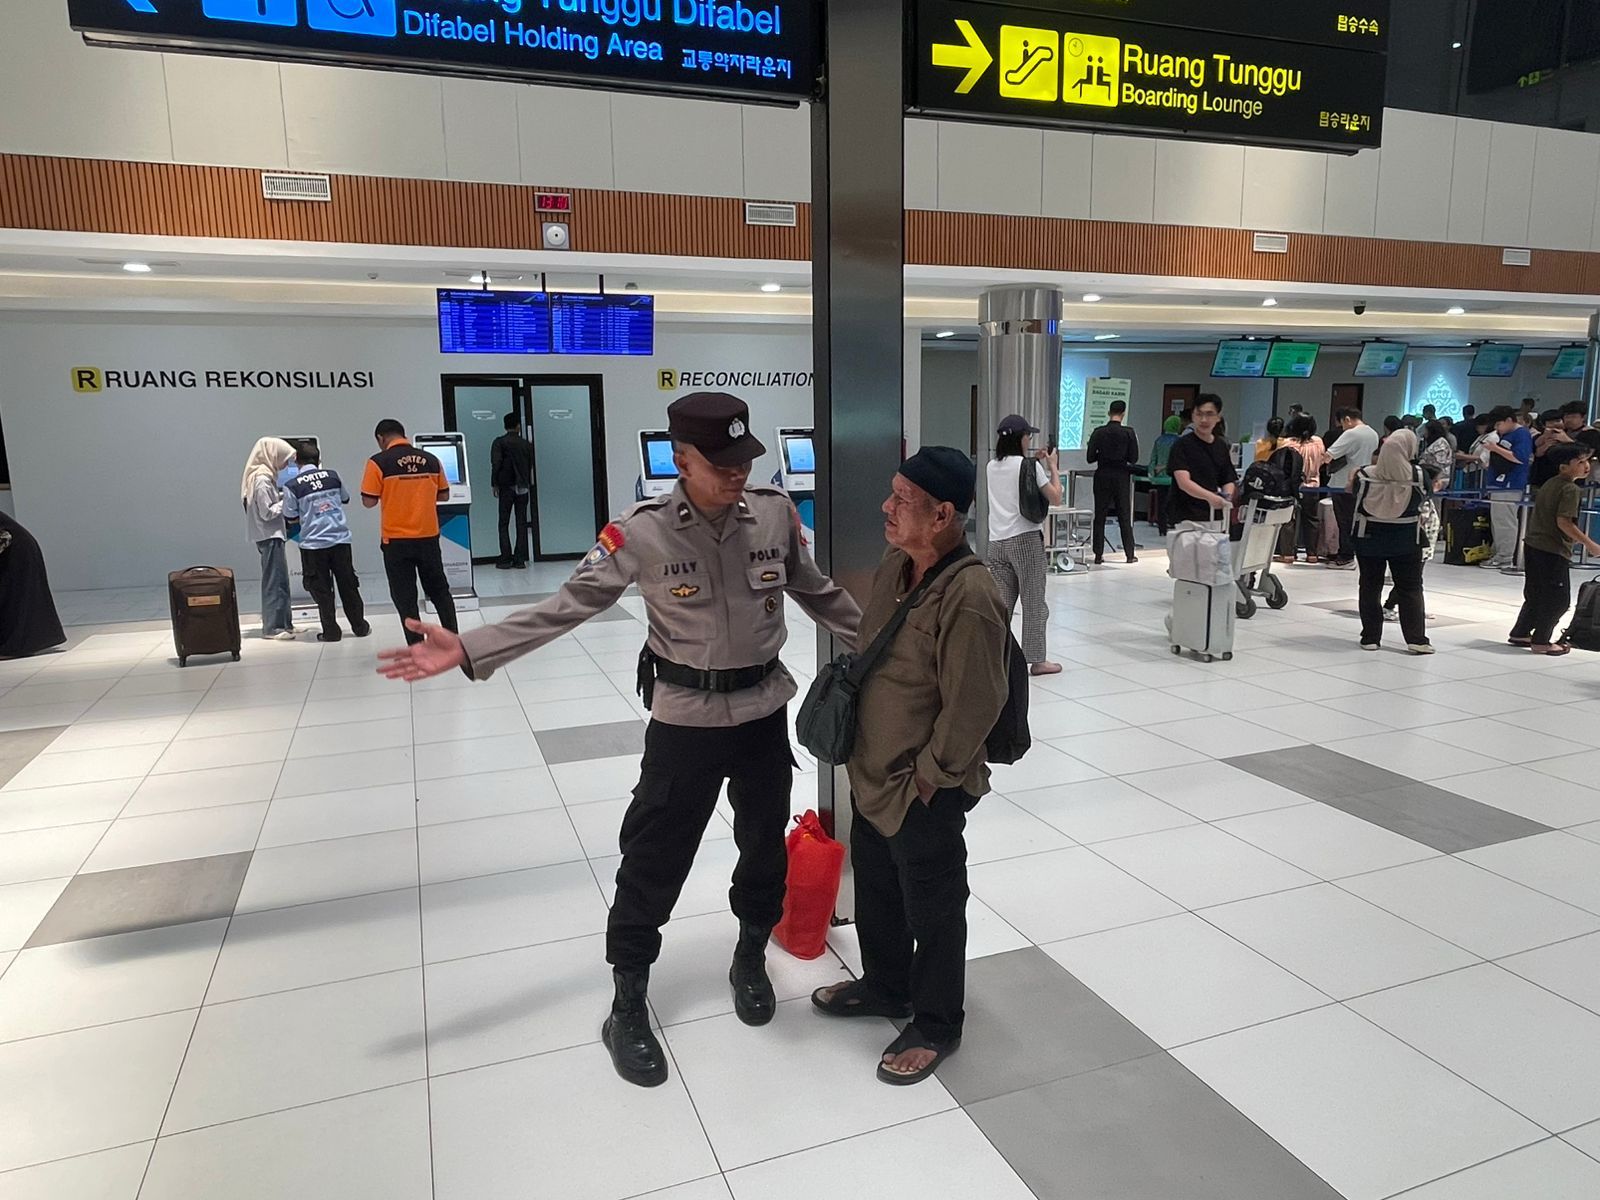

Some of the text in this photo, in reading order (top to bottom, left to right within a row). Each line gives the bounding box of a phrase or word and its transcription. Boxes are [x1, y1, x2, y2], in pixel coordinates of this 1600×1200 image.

[542, 0, 661, 26] unggu
[674, 0, 780, 35] Difabel
[1337, 15, 1379, 36] 탑승수속
[403, 10, 664, 61] Difabel Holding Area
[681, 49, 791, 79] 교통약자라운지
[1123, 44, 1301, 96] Ruang Tunggu
[1122, 83, 1263, 119] Boarding Lounge
[1319, 111, 1371, 131] 탑승라운지
[76, 369, 375, 389] R RUANG REKONSILIASI
[661, 371, 674, 387] R
[397, 455, 427, 467] PORTER
[296, 471, 329, 484] PORTER
[310, 480, 323, 490] 38
[663, 561, 697, 576] JULY
